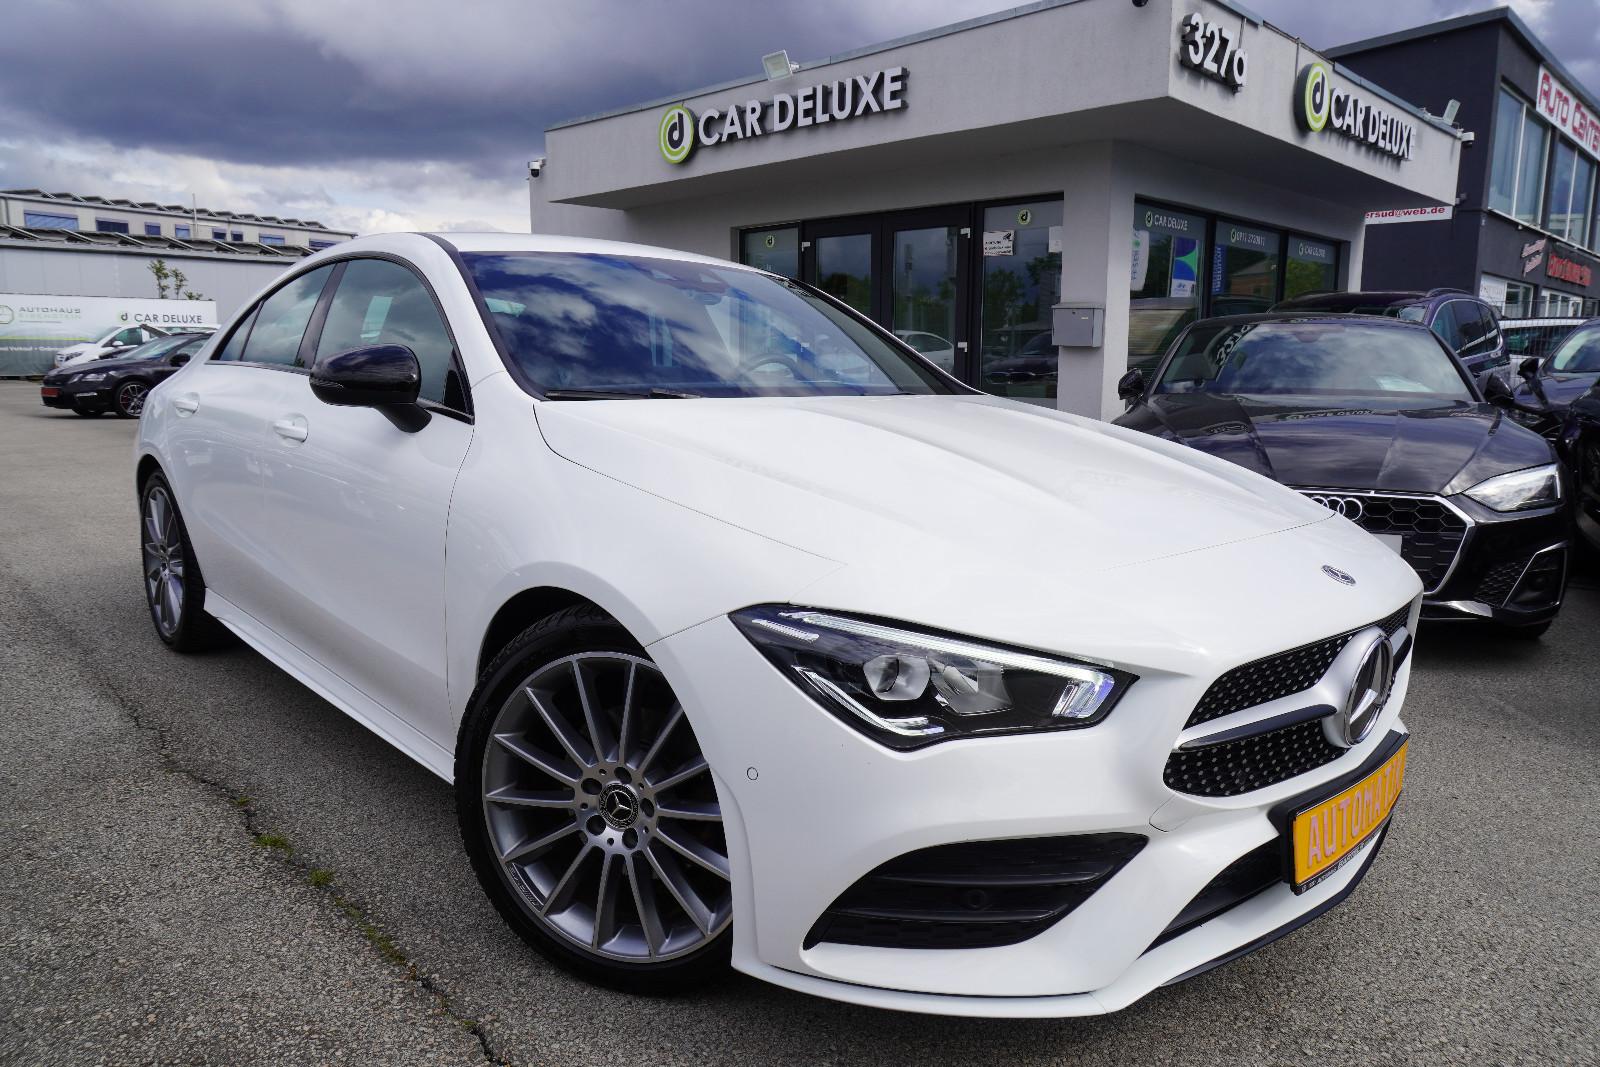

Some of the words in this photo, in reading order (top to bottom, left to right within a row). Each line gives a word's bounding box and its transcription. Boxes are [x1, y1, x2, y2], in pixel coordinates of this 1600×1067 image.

[1186, 12, 1248, 86] 327a
[698, 99, 762, 146] CAR
[773, 66, 903, 132] DELUXE
[1330, 87, 1365, 139] CAR
[1368, 105, 1416, 161] DELUXE
[19, 306, 81, 314] AUTOHAUS
[134, 313, 159, 322] CAR
[163, 314, 203, 324] DELUXE
